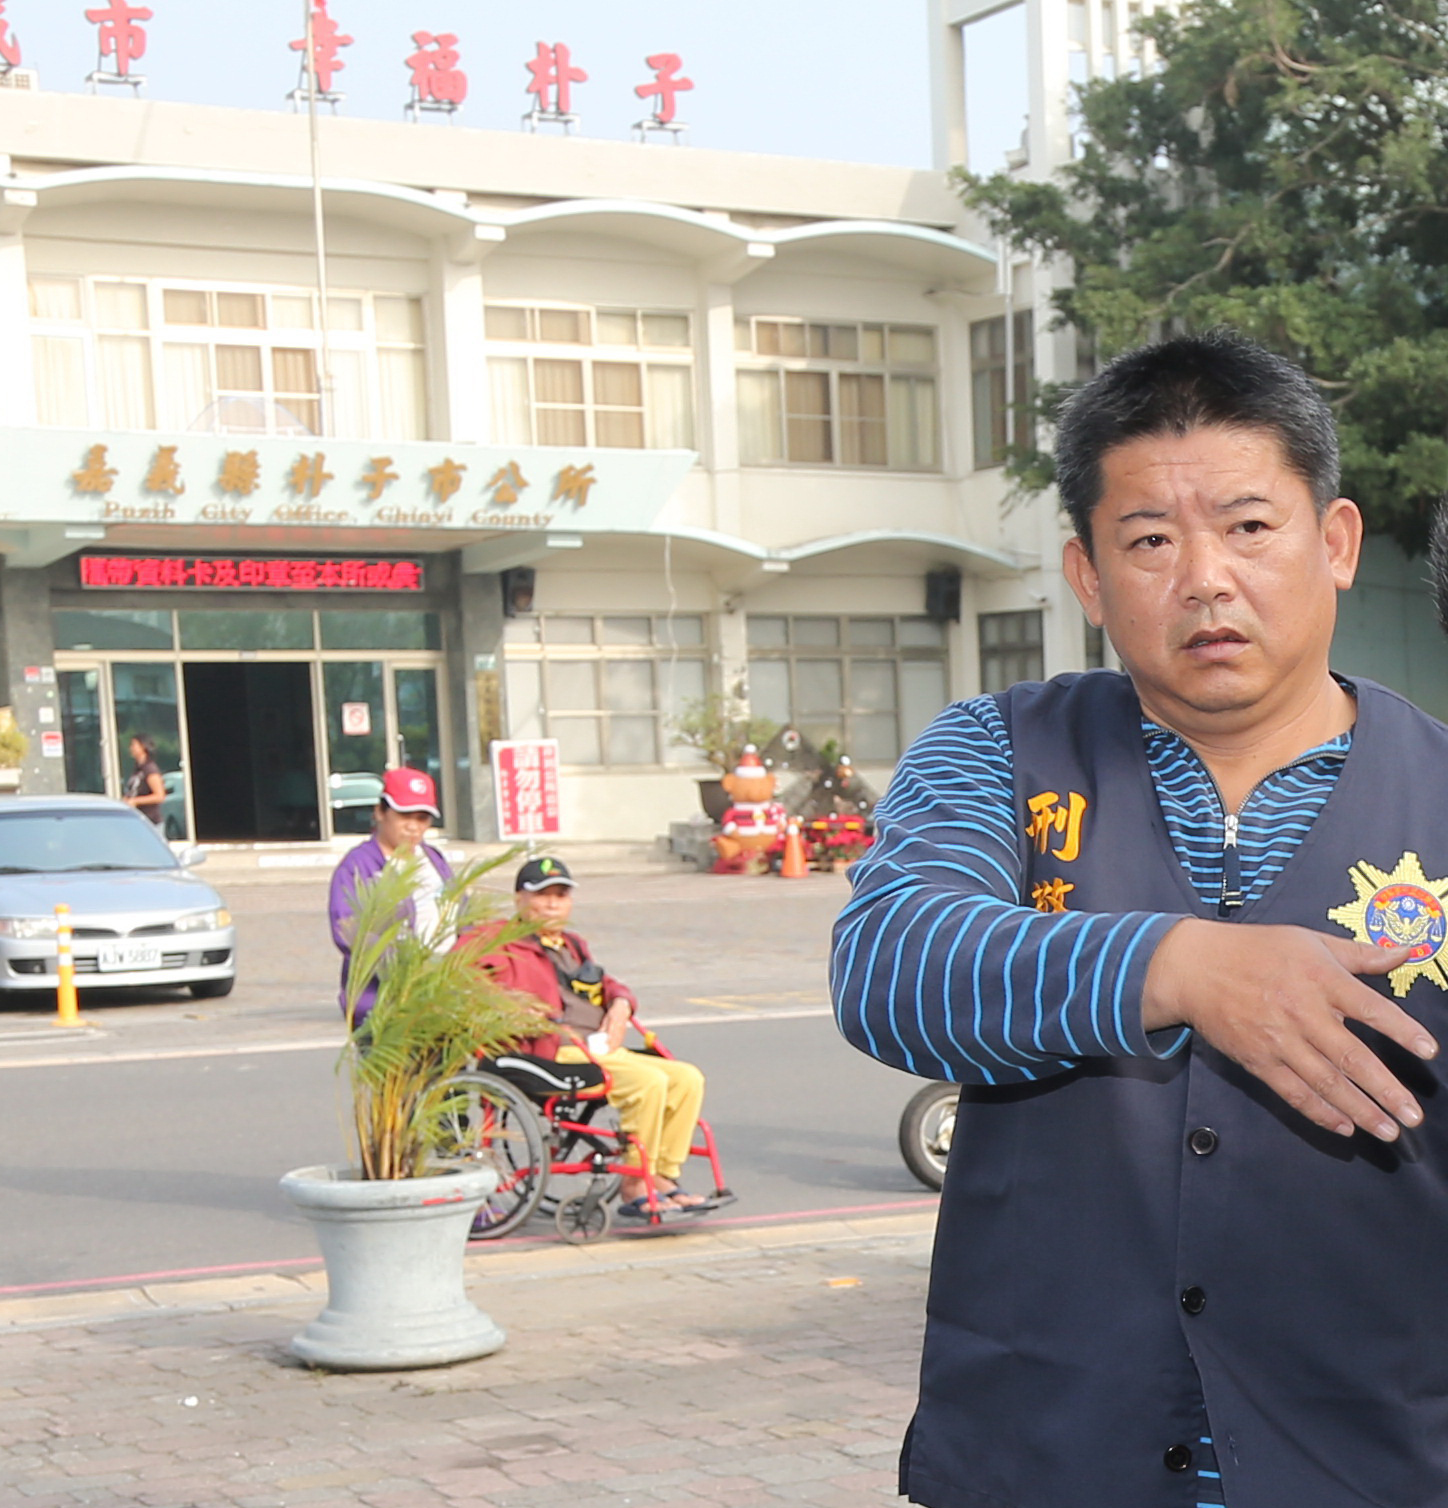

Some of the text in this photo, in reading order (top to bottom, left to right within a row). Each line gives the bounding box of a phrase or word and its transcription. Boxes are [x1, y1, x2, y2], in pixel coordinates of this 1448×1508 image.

[289, 0, 693, 122] 幸福朴子
[72, 444, 597, 506] 嘉義縣朴子市公所
[201, 503, 252, 523] City
[471, 508, 554, 527] County
